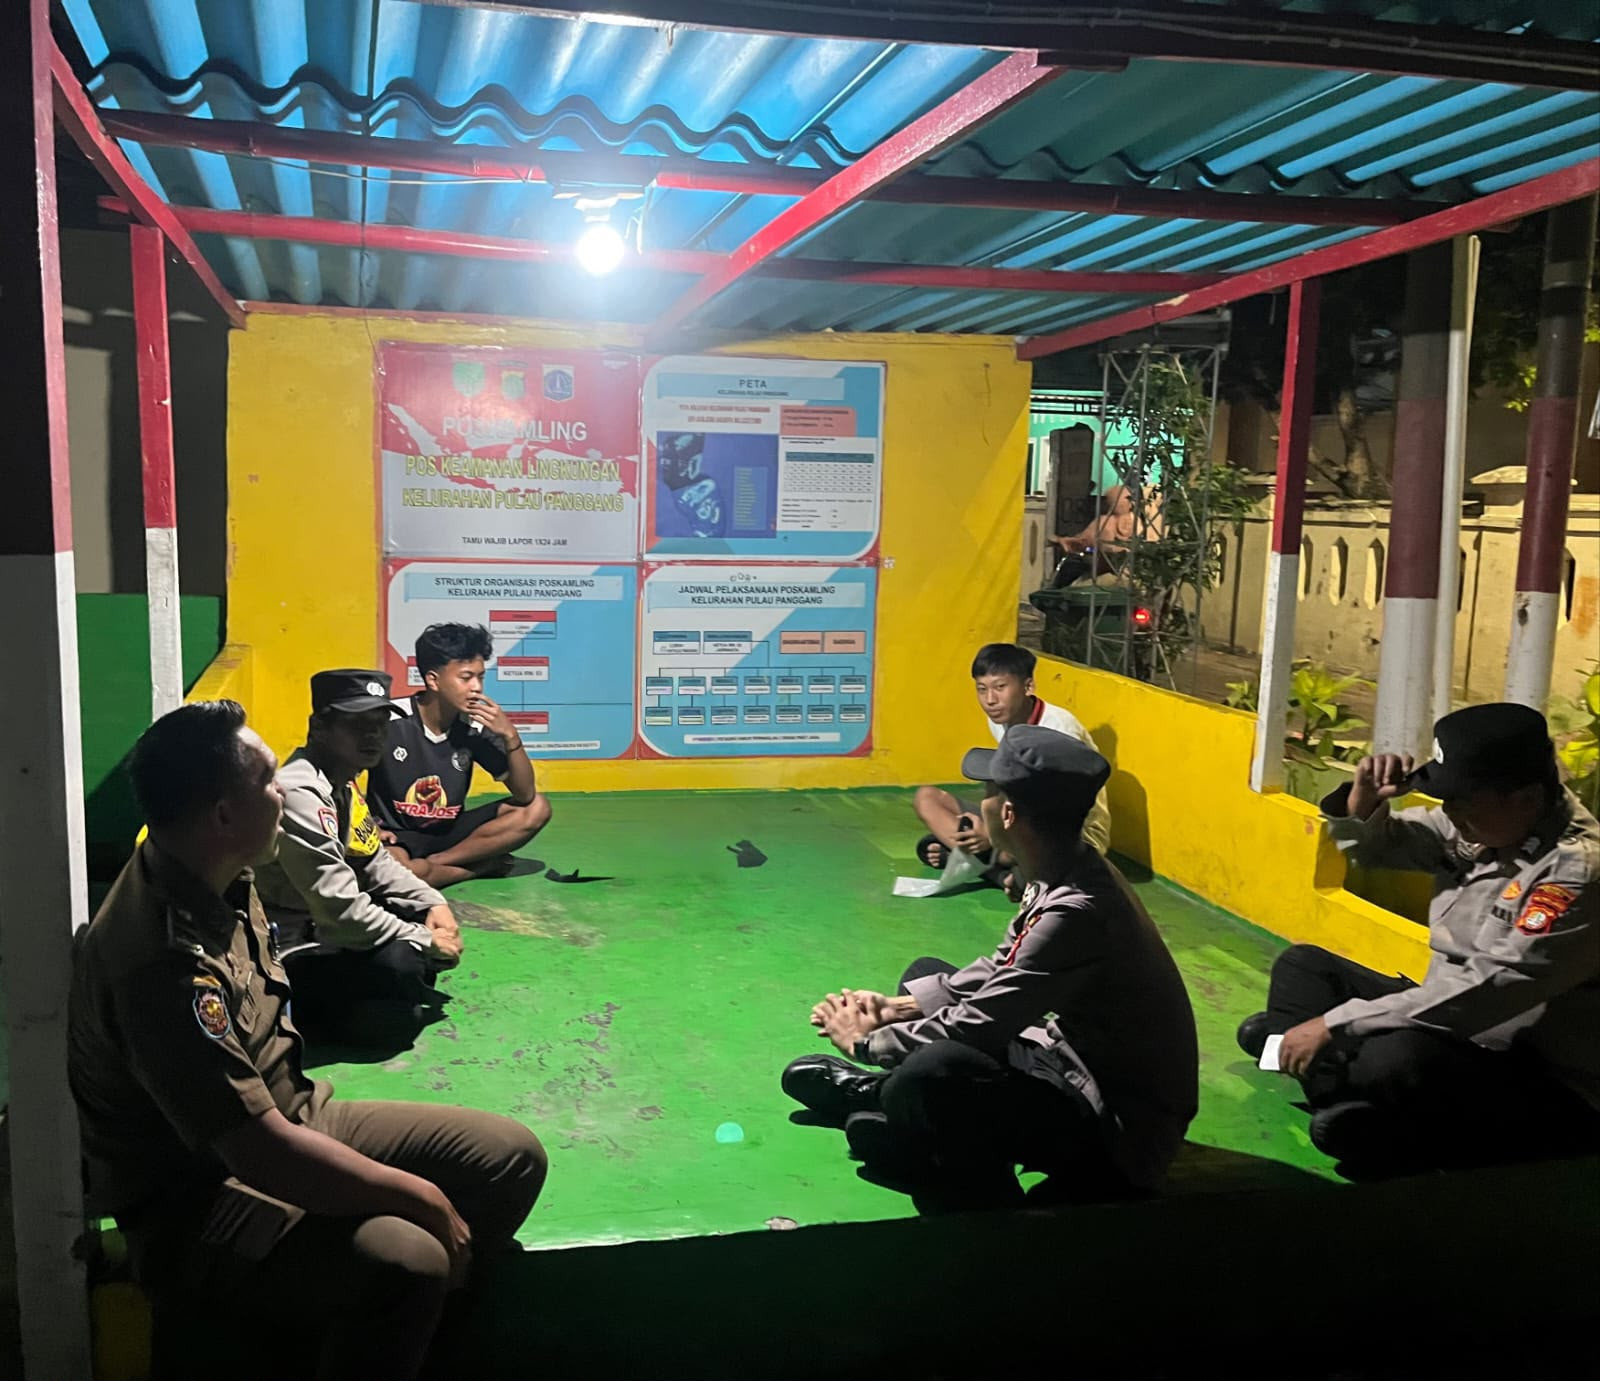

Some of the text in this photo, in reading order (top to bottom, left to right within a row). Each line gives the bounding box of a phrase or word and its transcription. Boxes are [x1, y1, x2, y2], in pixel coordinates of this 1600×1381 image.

[738, 379, 768, 389] PETA
[405, 455, 621, 482] POS KEAMANAN LINGKUNGAN
[402, 487, 625, 513] KELURAHAN PULAU PANGGANG
[461, 536, 482, 545] TAMU
[484, 537, 507, 545] WAJIB
[508, 537, 534, 545] LAPOR
[552, 538, 568, 546] JAM
[435, 577, 595, 588] STRUKTUR ORGANISASI POSKAMLING
[448, 588, 583, 598] KELURAHAN PULAU PANGGANG
[678, 585, 836, 595] JADWAL PELAKSANAAN POSKAMLING
[691, 596, 824, 605] KELURAHAN PULAU PANGGANG
